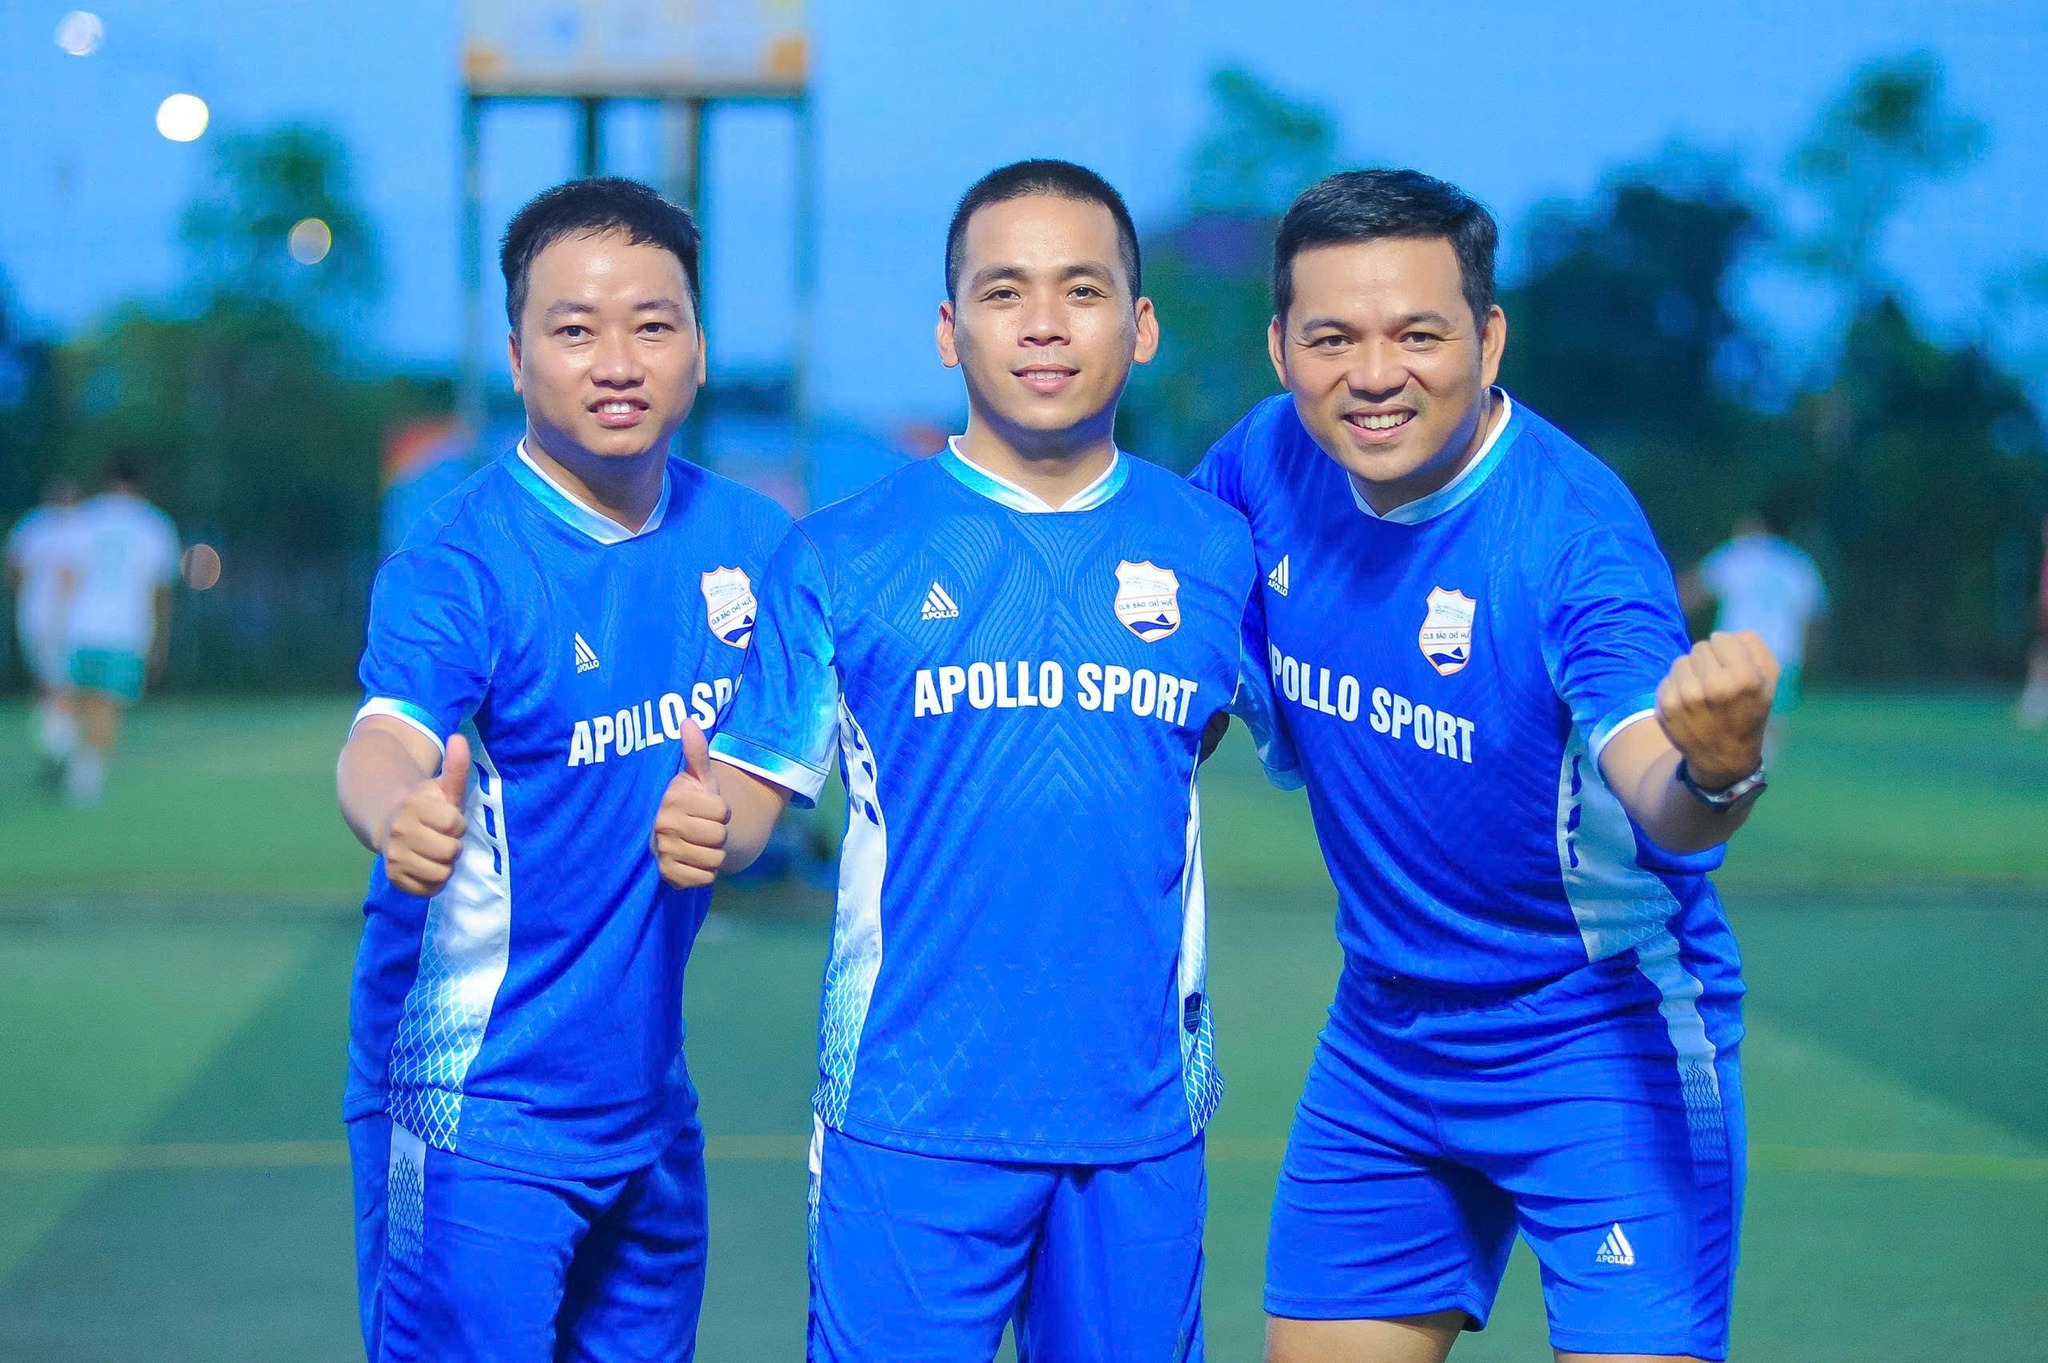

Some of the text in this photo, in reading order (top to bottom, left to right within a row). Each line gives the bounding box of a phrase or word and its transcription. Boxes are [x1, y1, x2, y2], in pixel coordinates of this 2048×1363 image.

[1267, 579, 1288, 597] APOLLO
[921, 609, 960, 621] APOLLO
[913, 660, 1198, 727] APOLLO SPORT
[1267, 636, 1475, 764] POLLO SPORT
[567, 692, 687, 767] APOLLO
[1595, 1254, 1635, 1265] APOLLO
